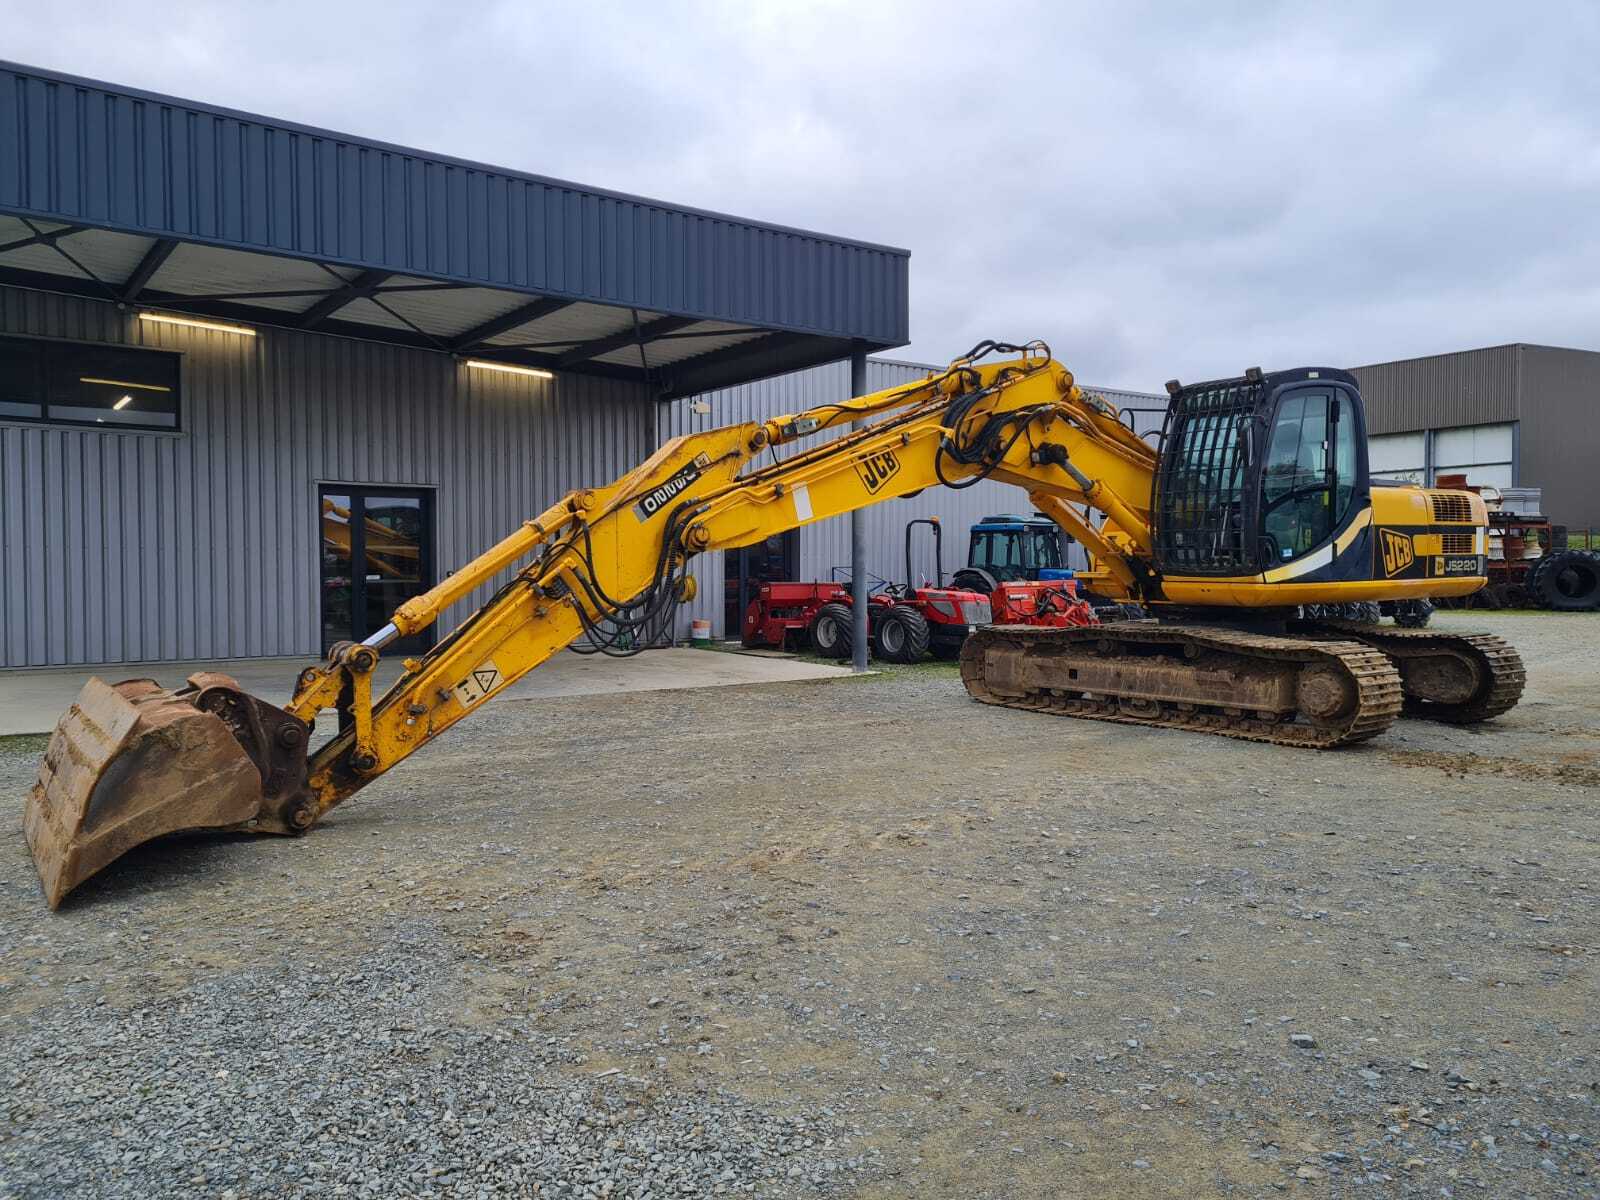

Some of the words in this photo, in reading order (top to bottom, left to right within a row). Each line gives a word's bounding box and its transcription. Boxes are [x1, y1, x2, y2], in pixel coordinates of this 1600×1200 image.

[858, 450, 897, 489] JCB
[1385, 533, 1412, 573] JCB
[1445, 559, 1477, 572] JS220
